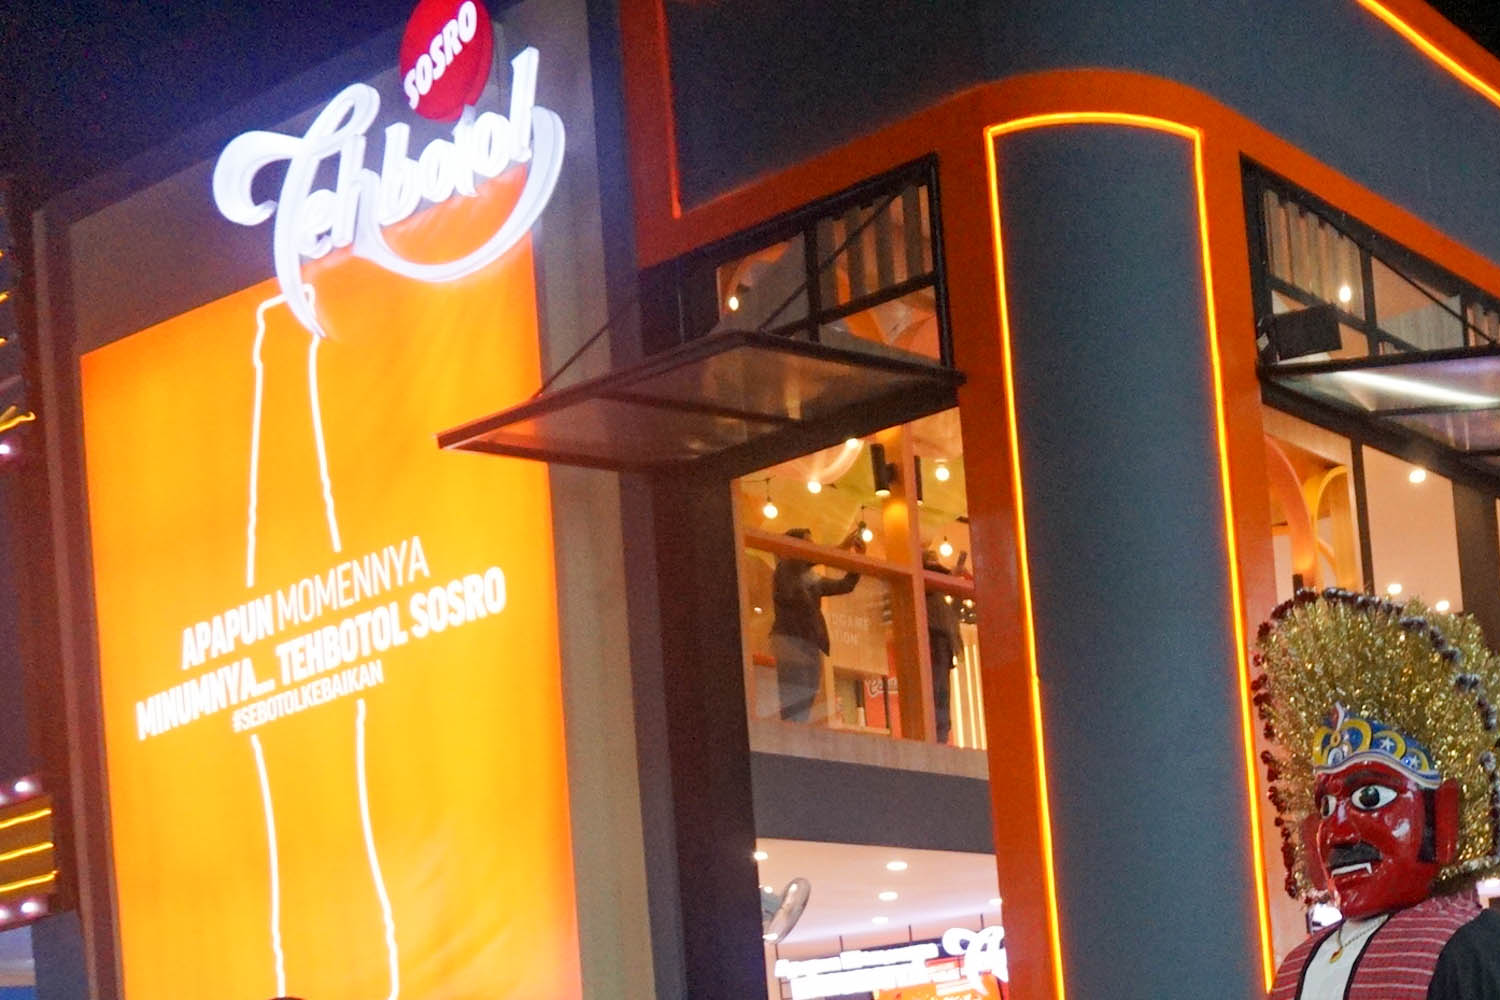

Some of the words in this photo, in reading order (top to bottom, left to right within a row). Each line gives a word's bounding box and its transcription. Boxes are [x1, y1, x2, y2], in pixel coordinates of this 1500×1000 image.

[404, 0, 478, 110] SOSRO
[213, 47, 566, 339] Tehbotol
[181, 593, 275, 671] APAPUN
[276, 534, 431, 632] MOMENNYA
[275, 600, 409, 687] TEHBOTOL
[409, 565, 507, 639] SOSRO
[231, 658, 385, 734] #SEBOTOLKEBAIKAN
